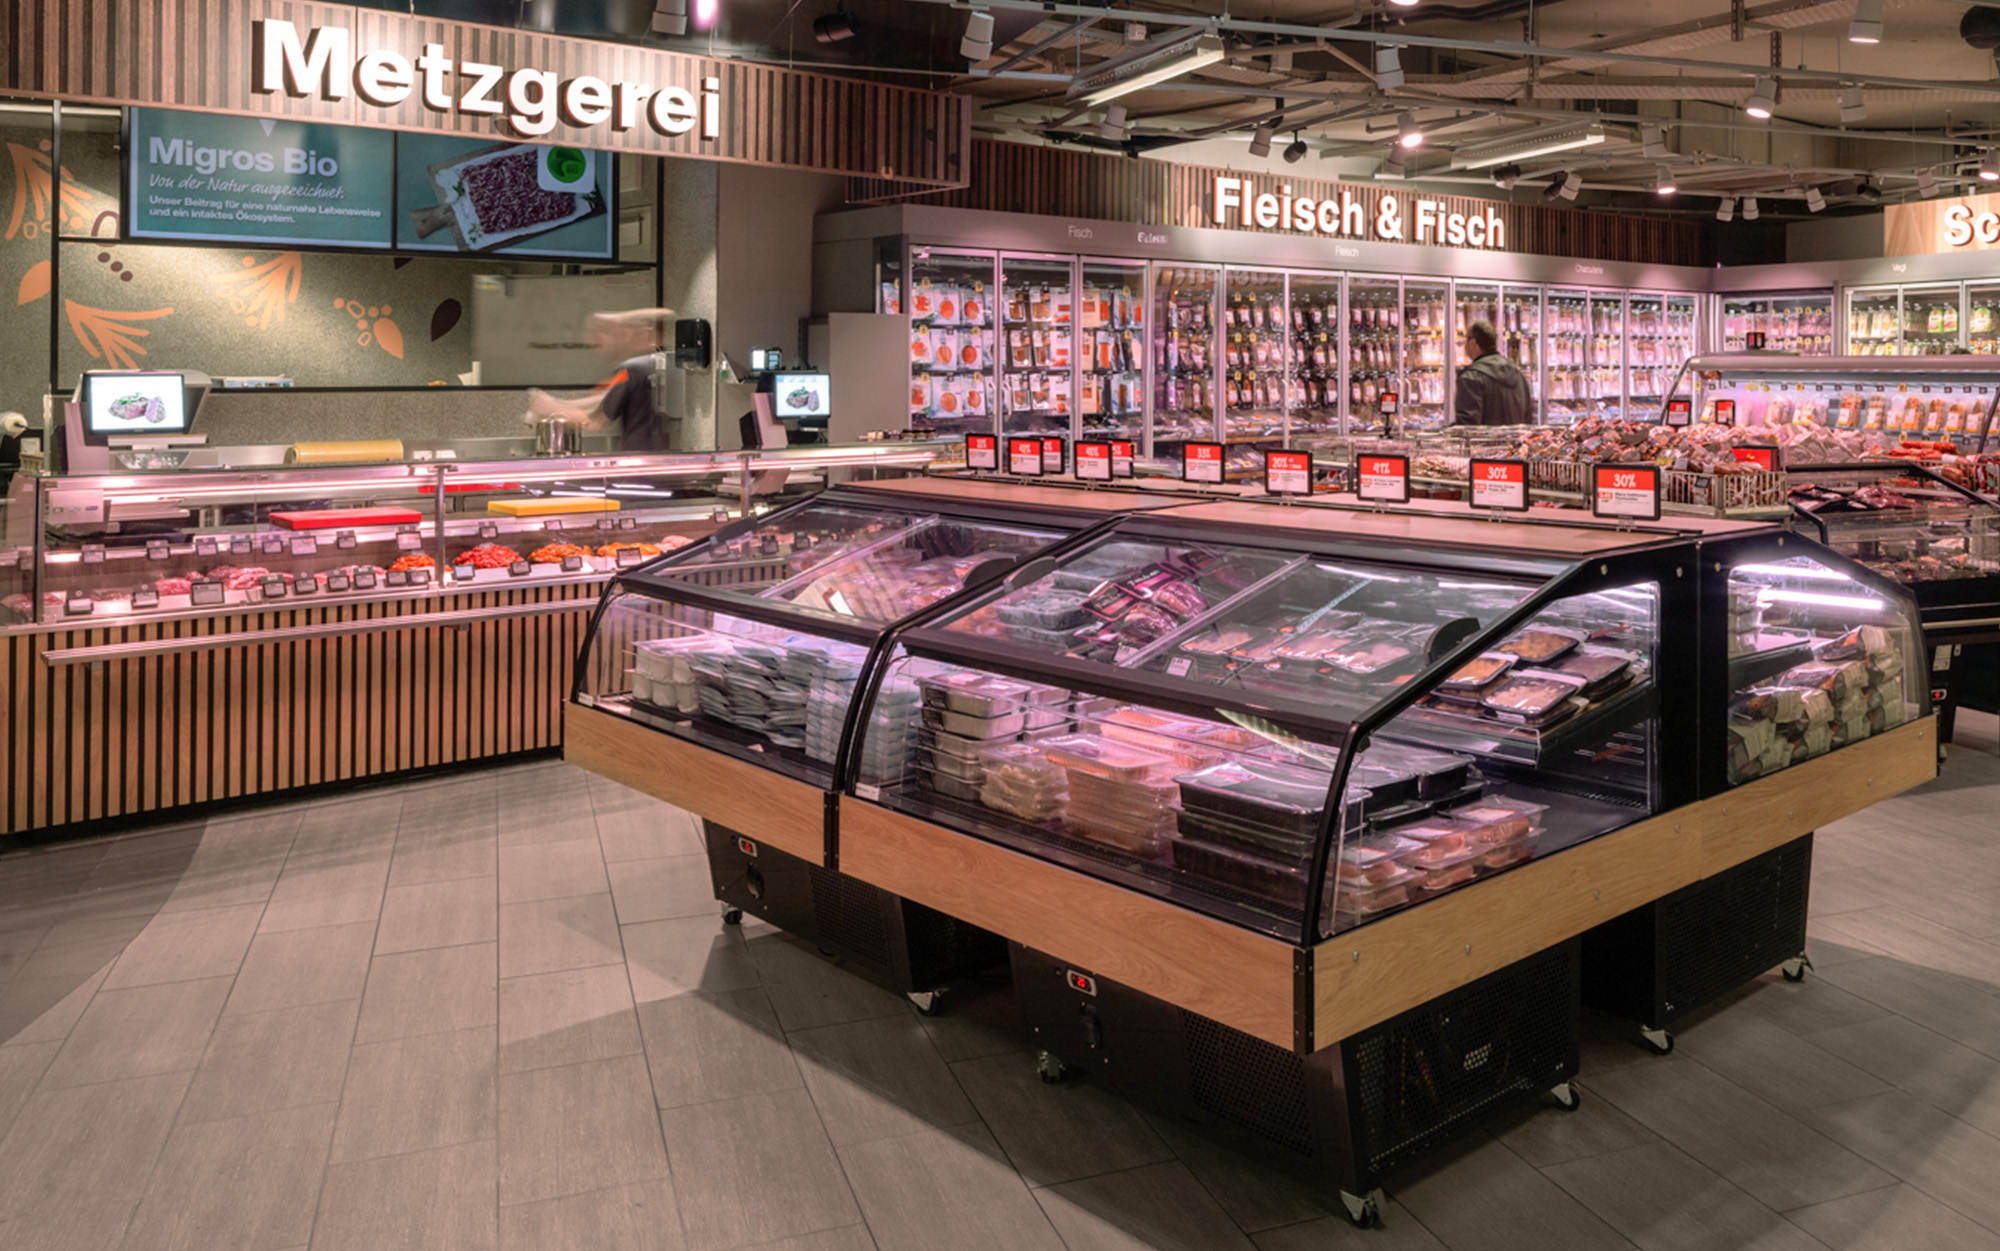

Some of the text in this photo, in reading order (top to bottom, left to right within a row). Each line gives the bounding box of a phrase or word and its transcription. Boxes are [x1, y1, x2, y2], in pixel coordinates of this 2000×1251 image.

[261, 18, 720, 138] Metzgerei
[149, 136, 339, 177] Migros Bio
[149, 174, 344, 201] Von der Natur ausgezeichnet.
[149, 195, 381, 217] Unser Beitrag für eine naturnahe Lebensweise
[149, 208, 296, 223] und ein intaktes Ökosystem.
[1214, 176, 1505, 248] Fleisch & Fisch
[1068, 225, 1093, 239] Fisch
[1944, 203, 2000, 247] Sc
[1335, 244, 1359, 257] Fleisch
[1372, 461, 1391, 475] 41%
[1486, 465, 1508, 480] 30%
[1612, 472, 1637, 488] 30%
